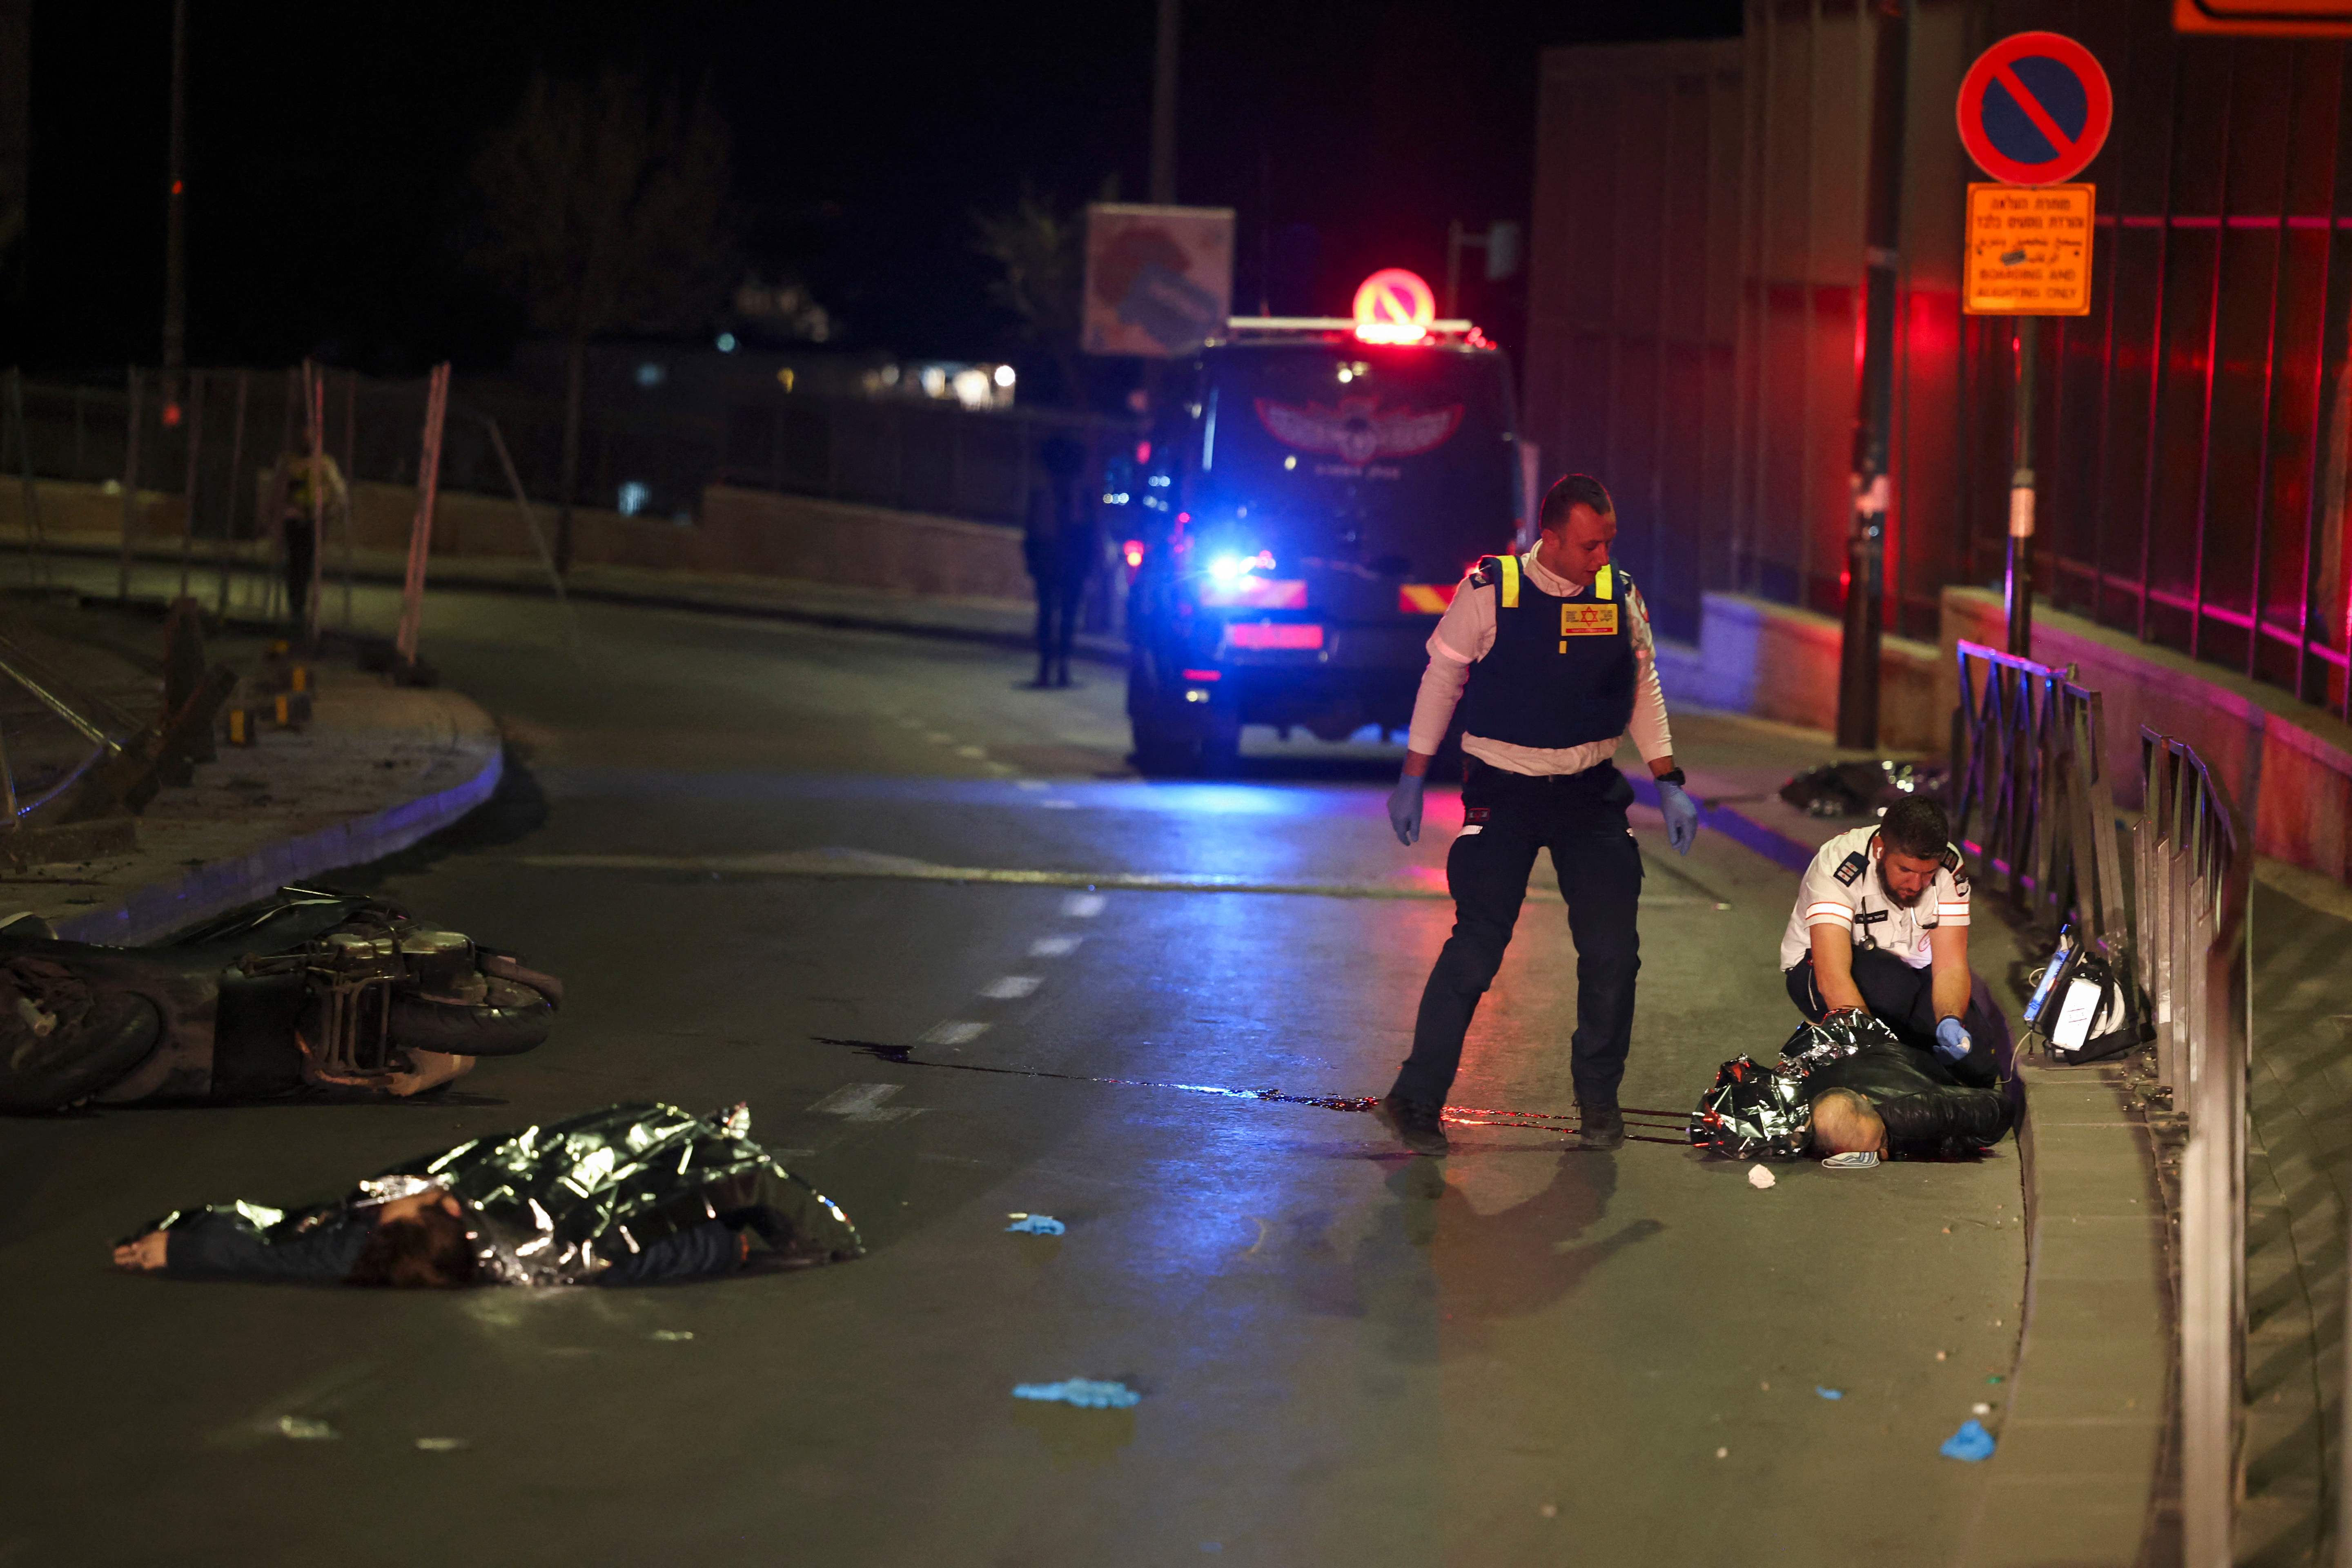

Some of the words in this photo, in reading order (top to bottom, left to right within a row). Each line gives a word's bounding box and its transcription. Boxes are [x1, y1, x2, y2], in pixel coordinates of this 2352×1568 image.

[1980, 268, 2043, 281] BOARDING
[2049, 269, 2076, 281] AND
[1976, 287, 2040, 298] ALIGHTING
[2046, 287, 2076, 299] ONLY
